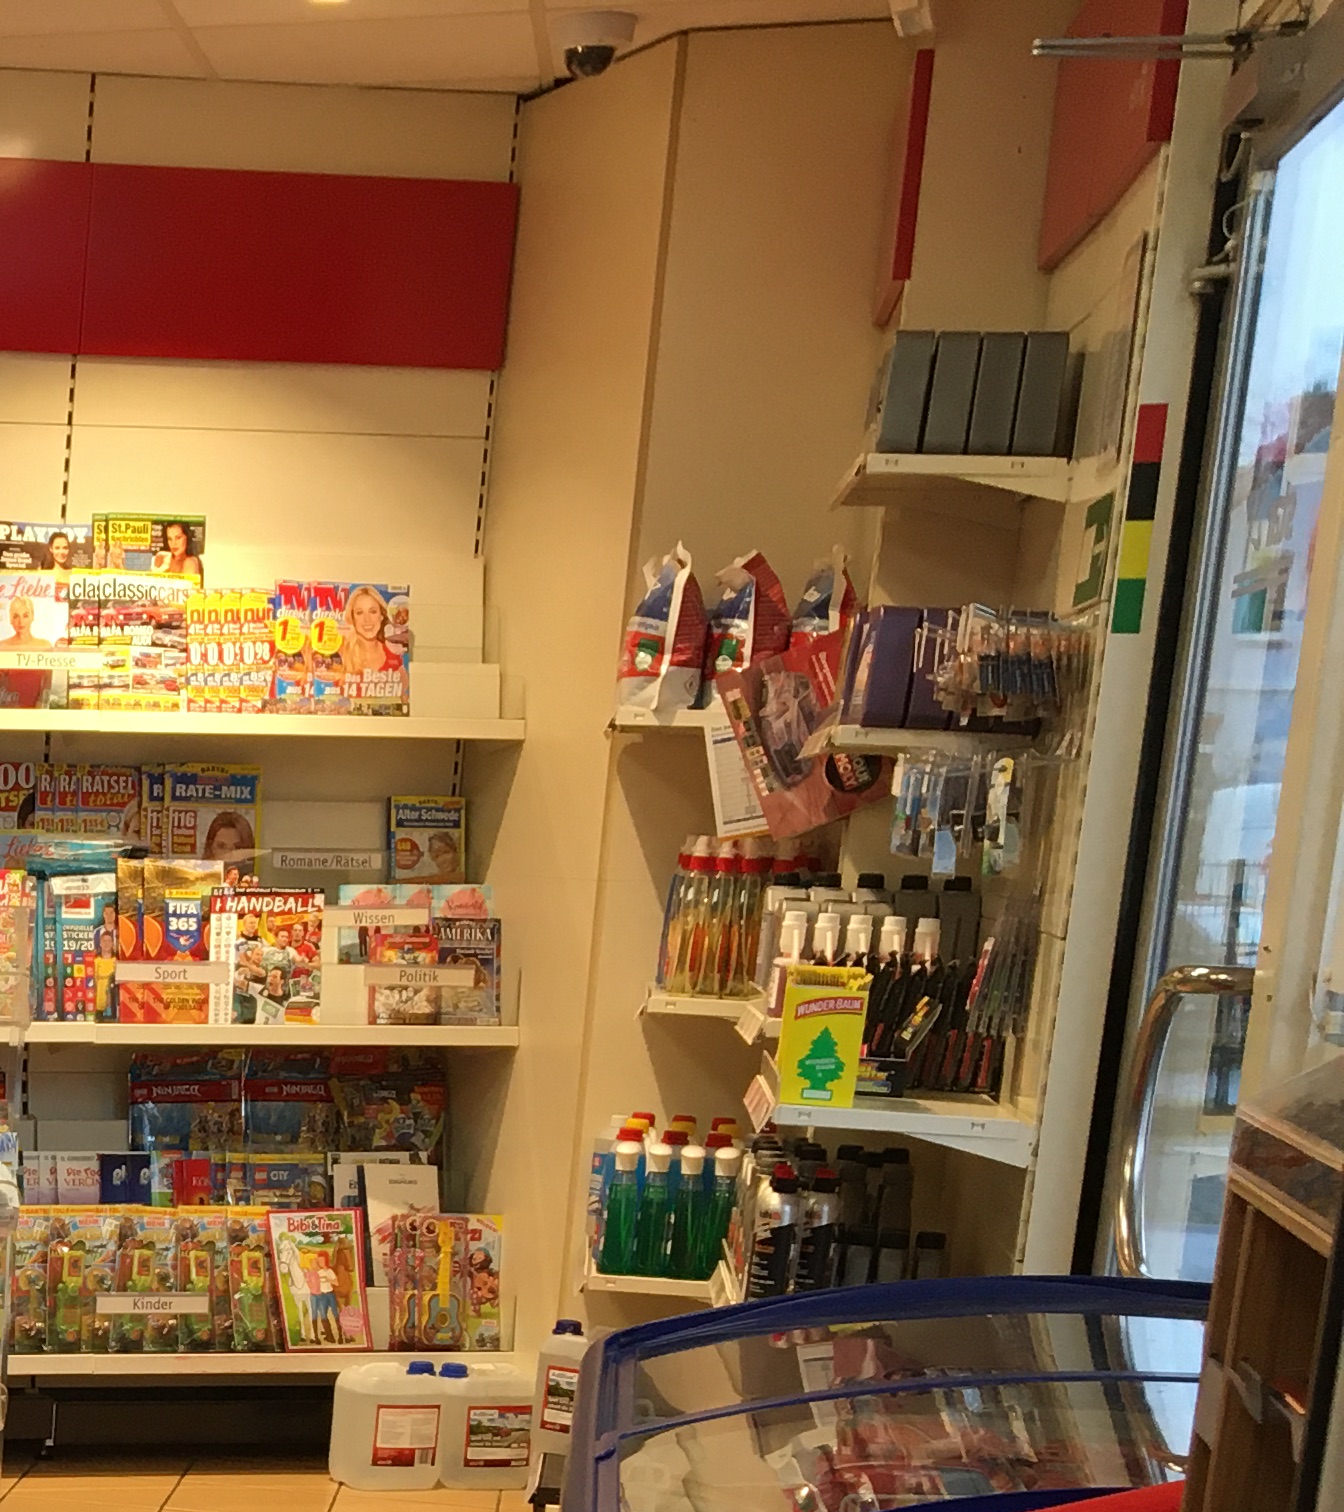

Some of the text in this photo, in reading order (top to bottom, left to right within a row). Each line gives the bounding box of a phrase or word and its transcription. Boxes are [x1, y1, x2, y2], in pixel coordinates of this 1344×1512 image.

[110, 522, 149, 535] St.Pauli
[102, 576, 191, 603] classiccars
[276, 607, 310, 619] direkt
[312, 608, 346, 619] direkt
[16, 652, 77, 667] TV-Presse
[363, 669, 401, 682] Beste
[343, 684, 357, 697] 14
[360, 683, 402, 697] TAGEN
[81, 773, 135, 795] RÄTSEL
[175, 783, 252, 800] RATE-MIX
[172, 809, 196, 830] 116
[280, 854, 373, 871] Romane/Rätsel
[168, 903, 198, 915] FIFA
[225, 898, 323, 914] HANDBALL
[168, 917, 198, 931] 365
[353, 911, 396, 925] Wissen
[63, 940, 95, 952] 19/20
[155, 966, 189, 982] Sport
[399, 969, 439, 984] Politik
[132, 1297, 173, 1312] Kinder
